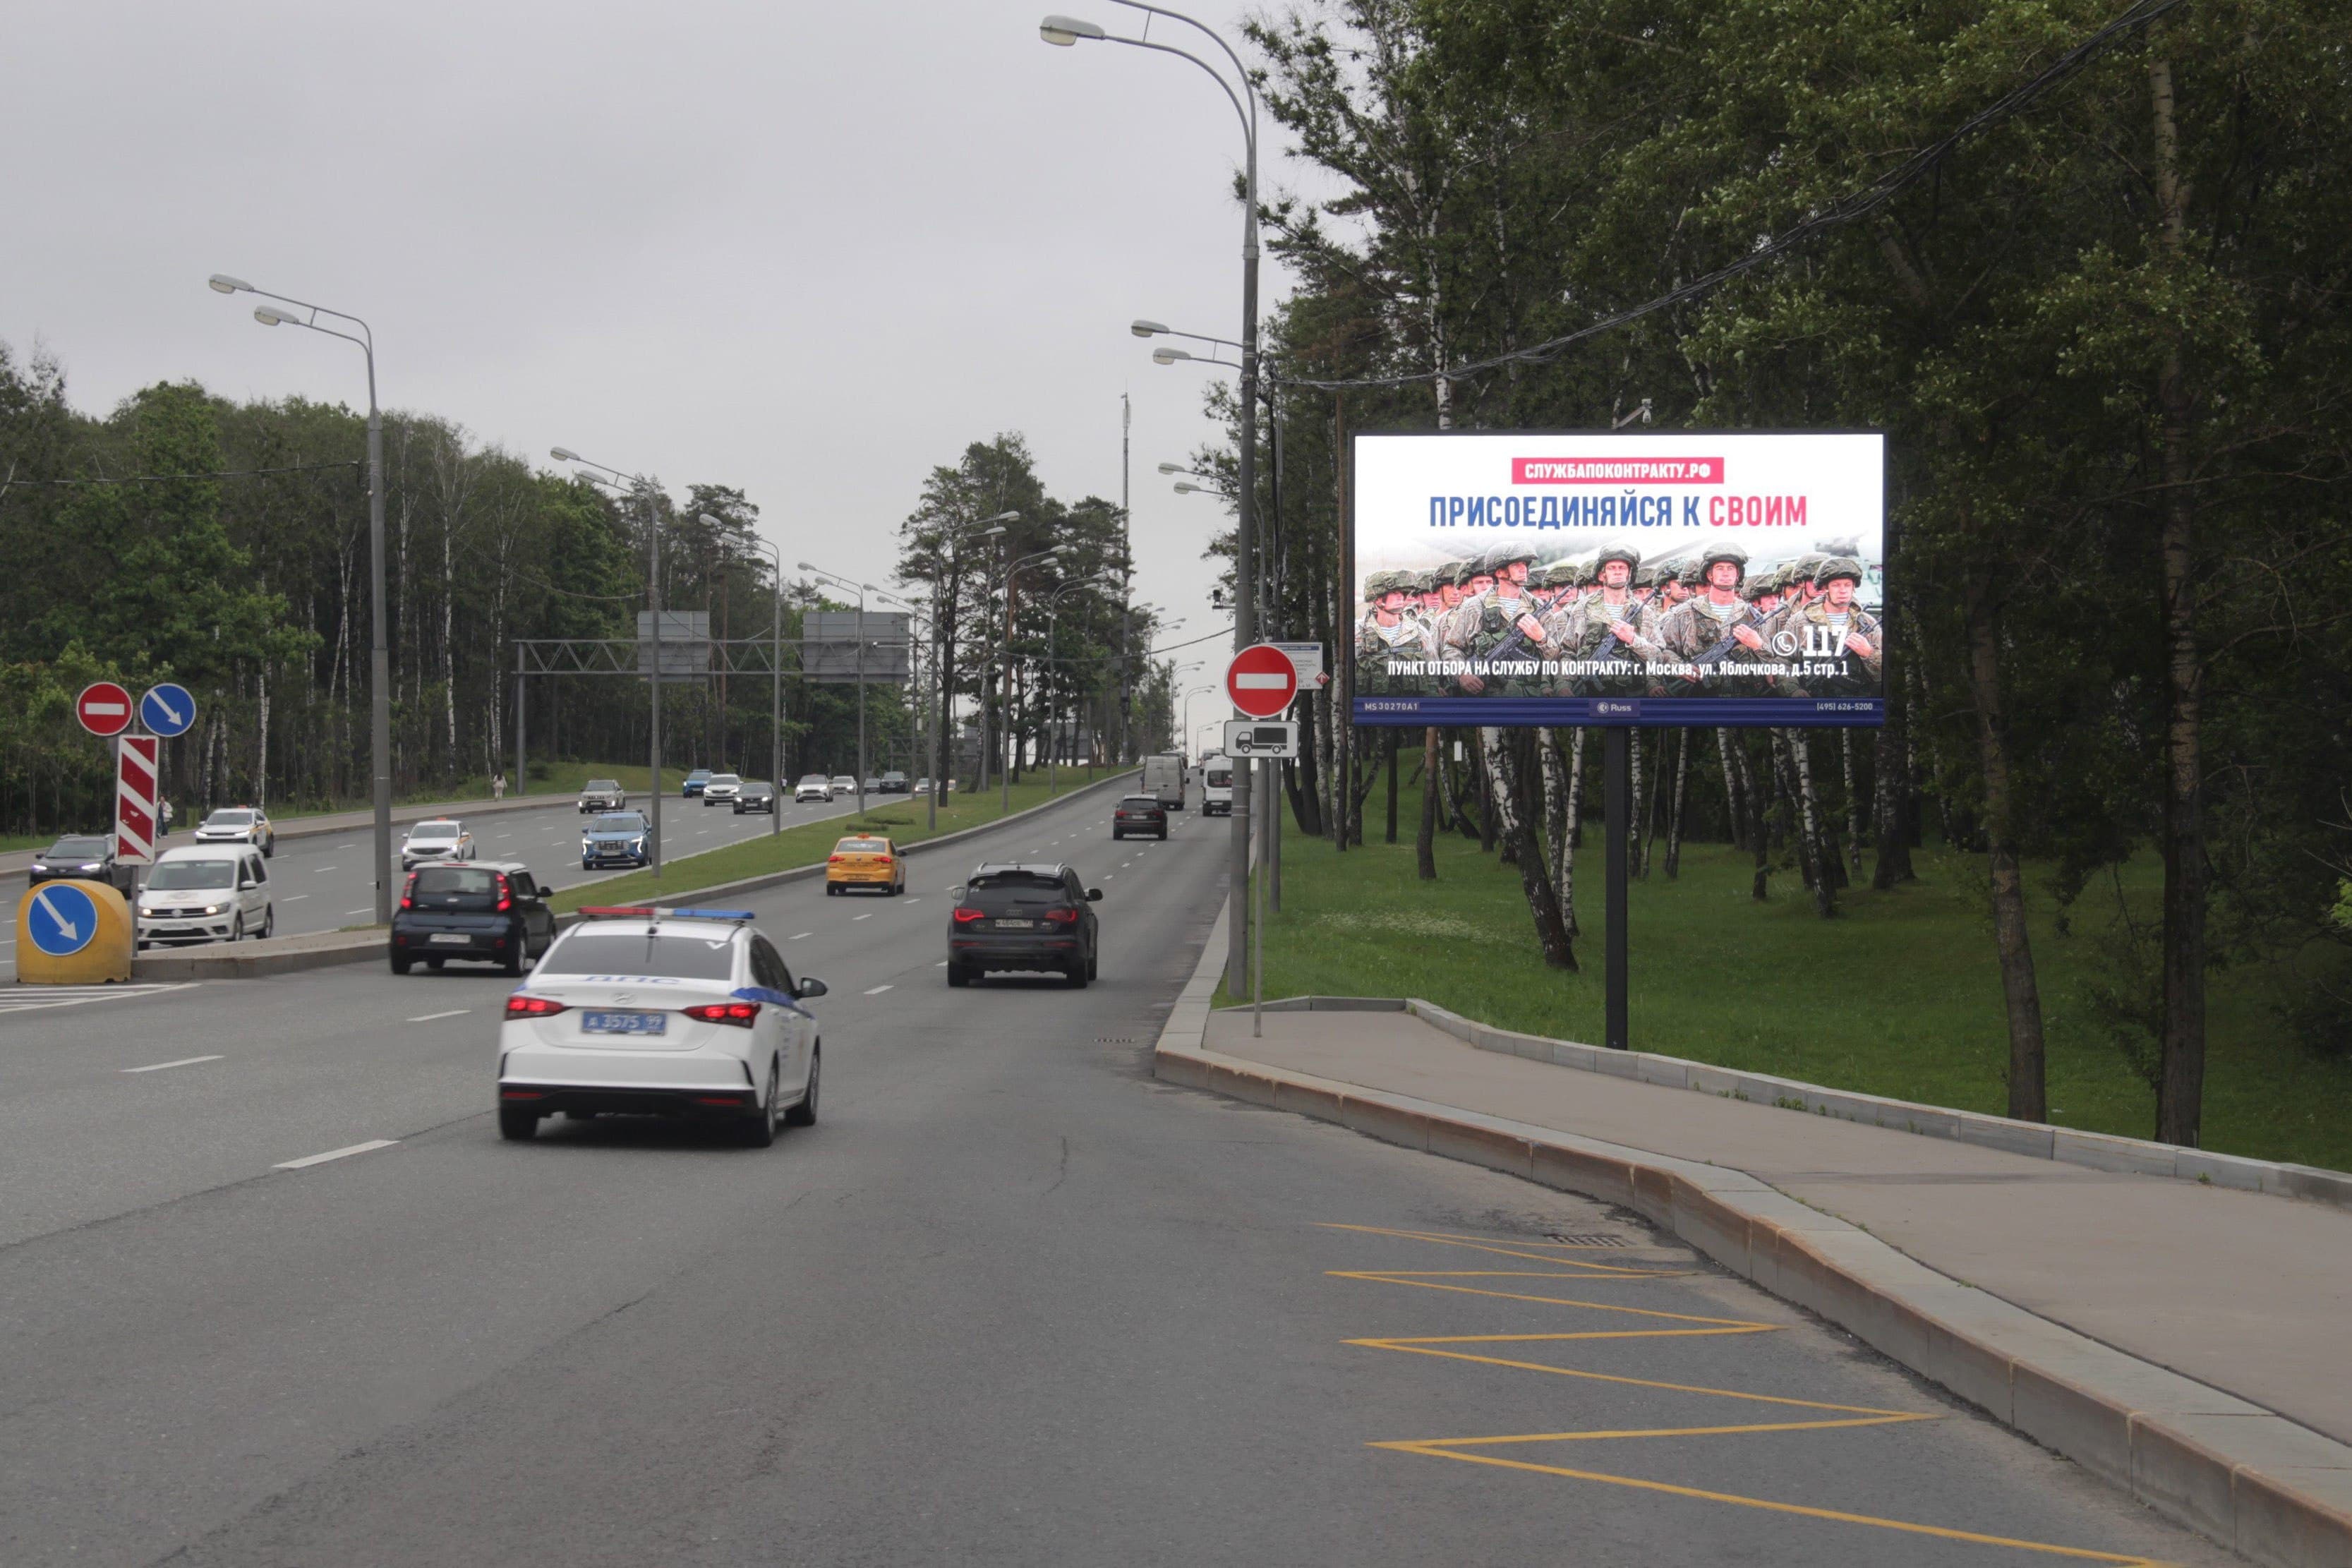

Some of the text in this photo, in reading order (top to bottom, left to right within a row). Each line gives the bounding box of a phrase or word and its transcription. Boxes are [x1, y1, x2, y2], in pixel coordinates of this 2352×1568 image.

[1524, 463, 1711, 480] СЛУЖБАПОКОНТРАКТУ.РФ
[1430, 489, 1807, 530] ПРИСОЕДИНЯЙСЯ К СВОИМ
[1803, 625, 1848, 657] 117
[1388, 661, 1424, 675] ПУНКТ
[1428, 661, 1473, 675] ОТБОРА
[1475, 661, 1490, 675] НА
[1492, 661, 1539, 675] СЛУЖБУ
[1542, 661, 1559, 675] ПО
[1561, 661, 1632, 676] КОНТРАКТУ:
[1646, 661, 1696, 677] Москва,
[1700, 663, 1717, 678] ул.
[1719, 661, 1790, 677] Яблочкова,
[1814, 663, 1838, 678] стр.
[1841, 662, 1848, 675] 1
